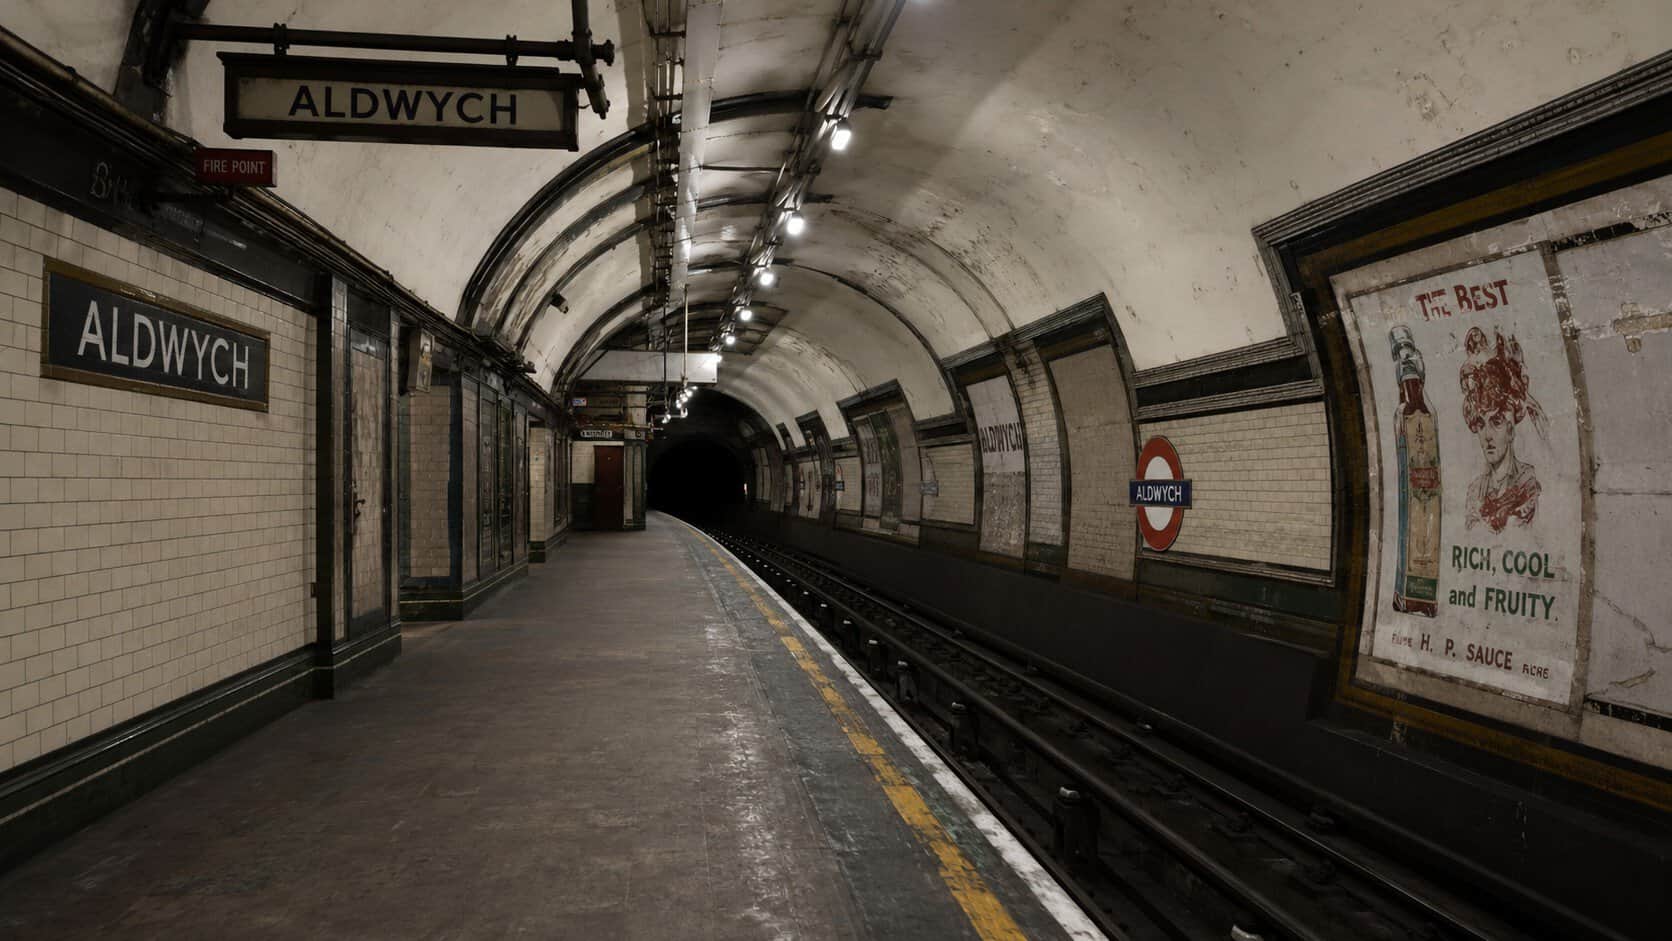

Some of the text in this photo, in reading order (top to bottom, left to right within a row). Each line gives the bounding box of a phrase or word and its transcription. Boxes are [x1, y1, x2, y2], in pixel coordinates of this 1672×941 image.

[289, 85, 517, 125] ALDWYCH
[203, 159, 265, 175] FIRE POINT
[1453, 280, 1509, 312] BEST
[77, 300, 249, 390] ALDWYCH
[980, 422, 1024, 453] ALDWYCH
[1136, 485, 1182, 503] ALDWYCH
[1452, 545, 1555, 578] RICH, COOL
[1448, 585, 1476, 608] and
[1484, 587, 1559, 621] FRUITY.
[1466, 643, 1513, 670] SAUCE
